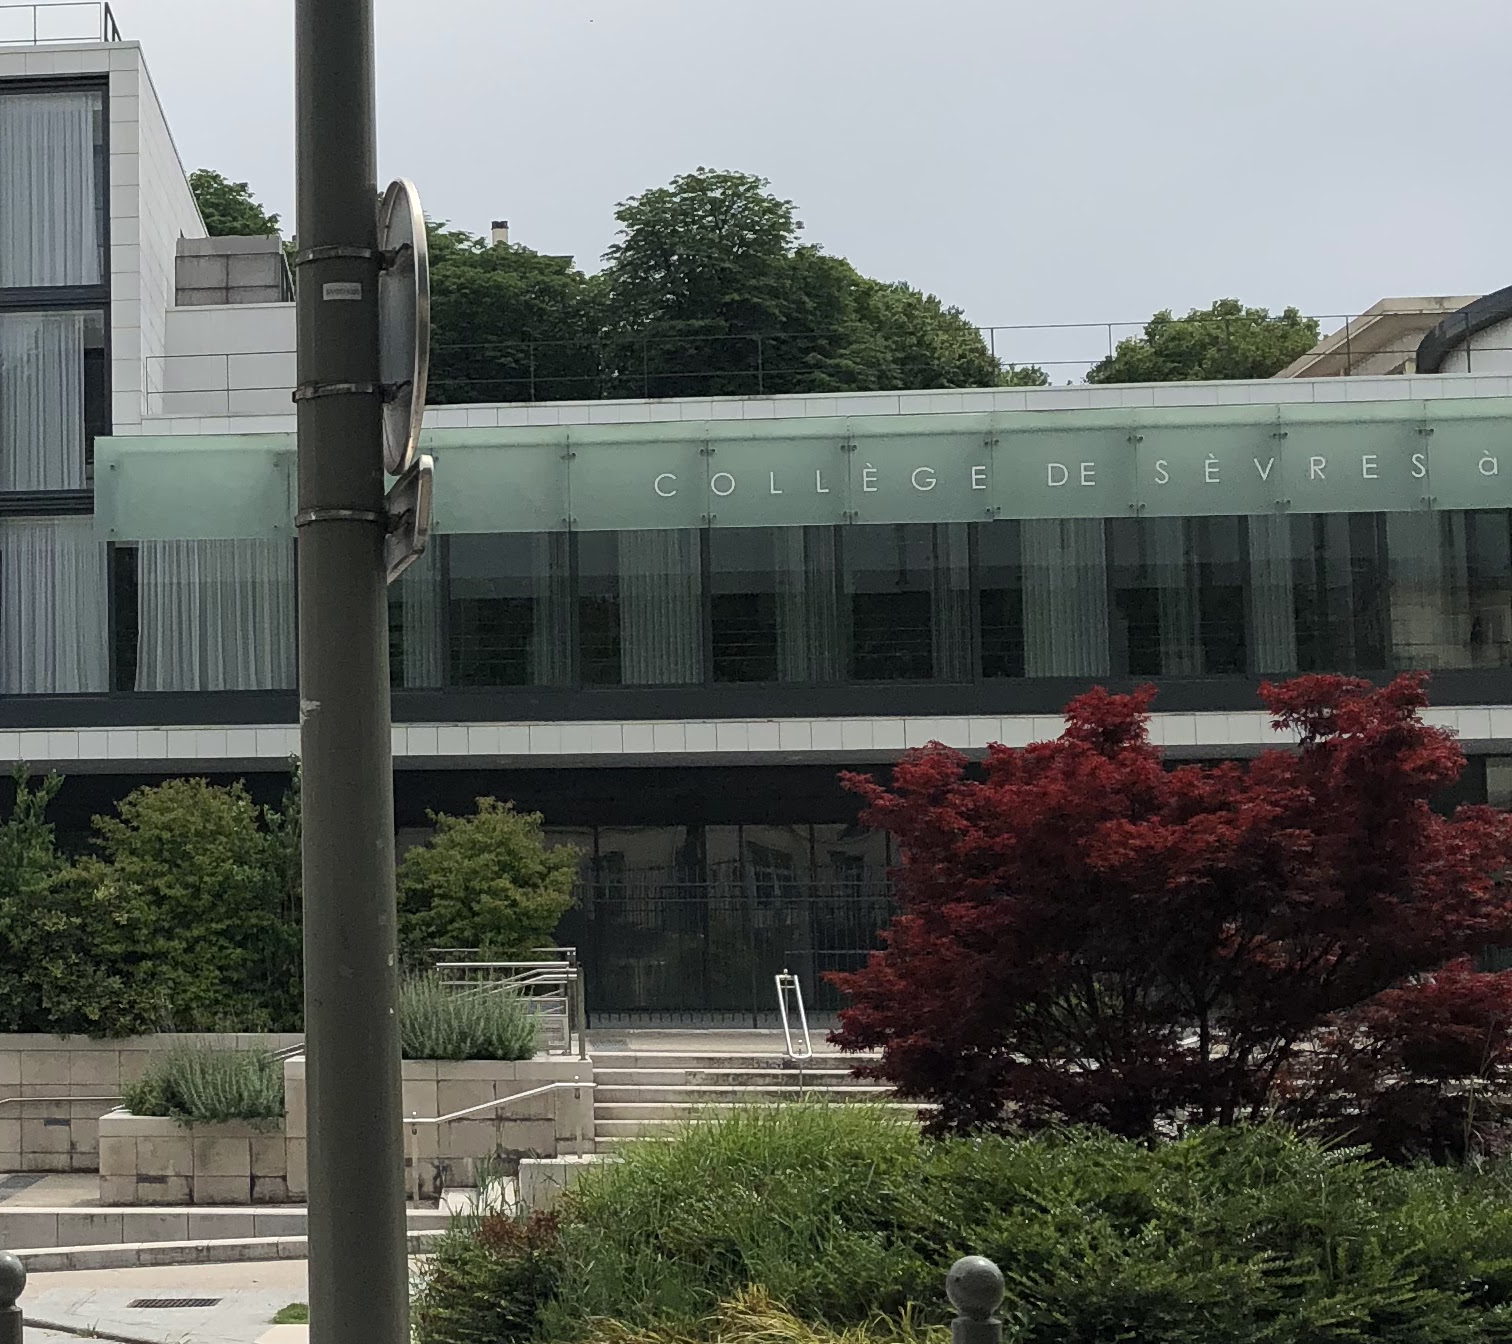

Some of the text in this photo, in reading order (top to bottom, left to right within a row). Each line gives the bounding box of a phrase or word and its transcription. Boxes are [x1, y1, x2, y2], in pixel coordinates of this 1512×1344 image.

[654, 449, 1499, 497] COLLÈGE DE SÈVRES à
